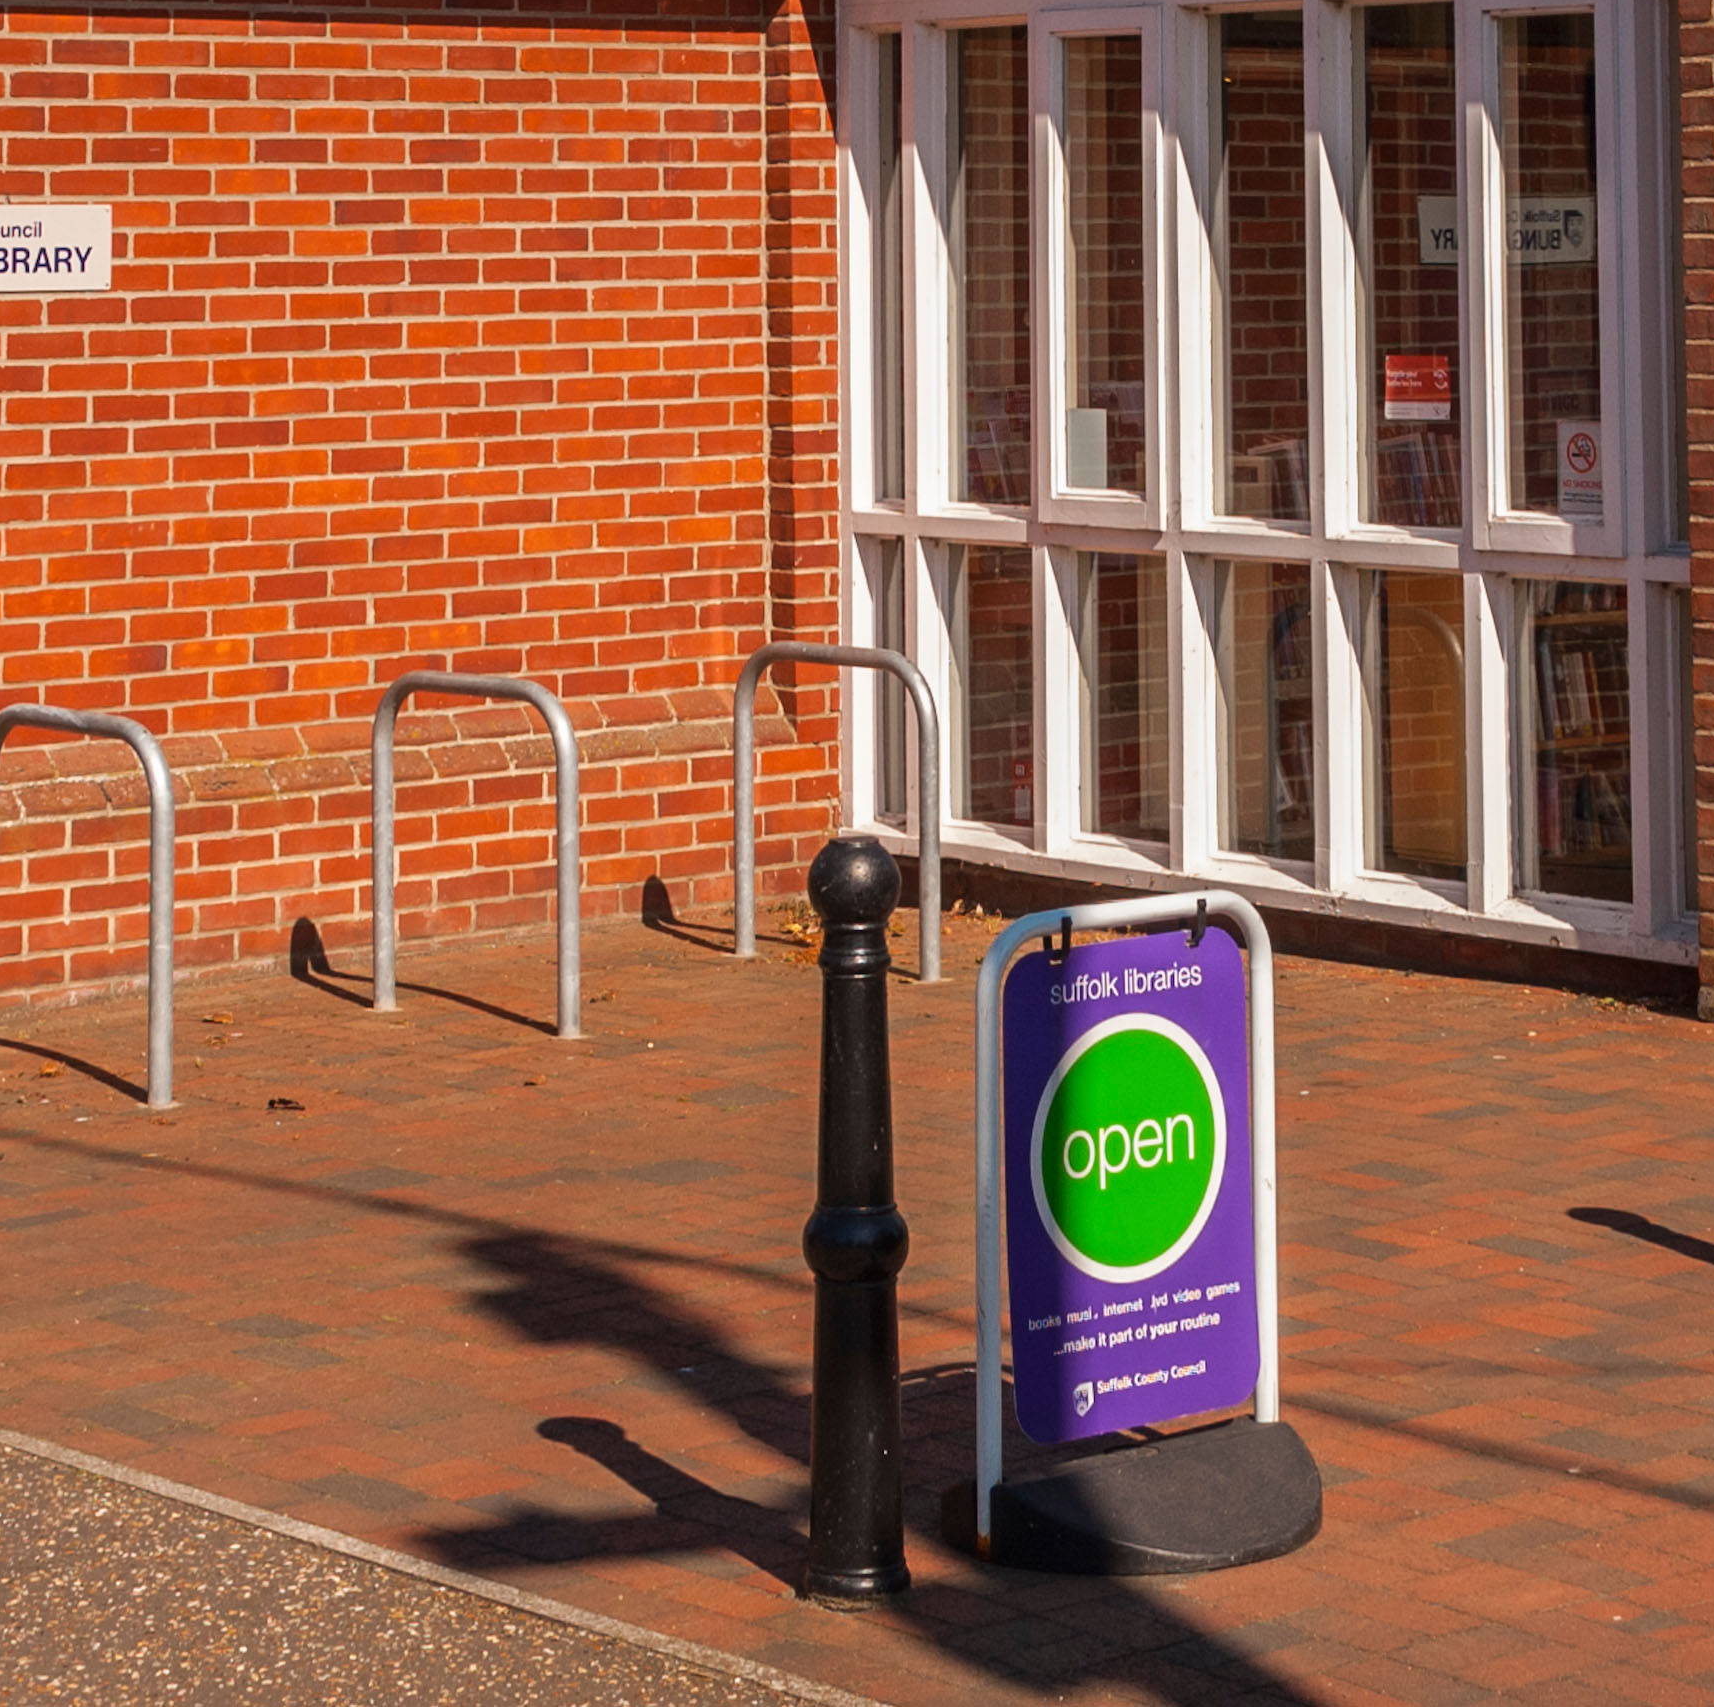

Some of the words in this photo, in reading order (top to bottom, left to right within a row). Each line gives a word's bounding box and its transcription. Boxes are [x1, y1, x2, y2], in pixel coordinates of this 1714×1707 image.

[1049, 972, 1120, 1006] suffolk
[1124, 961, 1203, 996] libraries
[1063, 1113, 1195, 1190] open
[1028, 1314, 1062, 1331] books
[1066, 1305, 1099, 1325] musi
[1102, 1297, 1144, 1317] internet
[1172, 1288, 1202, 1305] video
[1206, 1281, 1241, 1301] games
[1098, 1331, 1107, 1347] it
[1109, 1327, 1134, 1349] part
[1135, 1322, 1148, 1340] of
[1149, 1319, 1178, 1341] your
[1179, 1311, 1221, 1332] routine
[1096, 1374, 1133, 1395] Suffolk
[1133, 1368, 1169, 1387] County
[1170, 1359, 1206, 1379] Council
